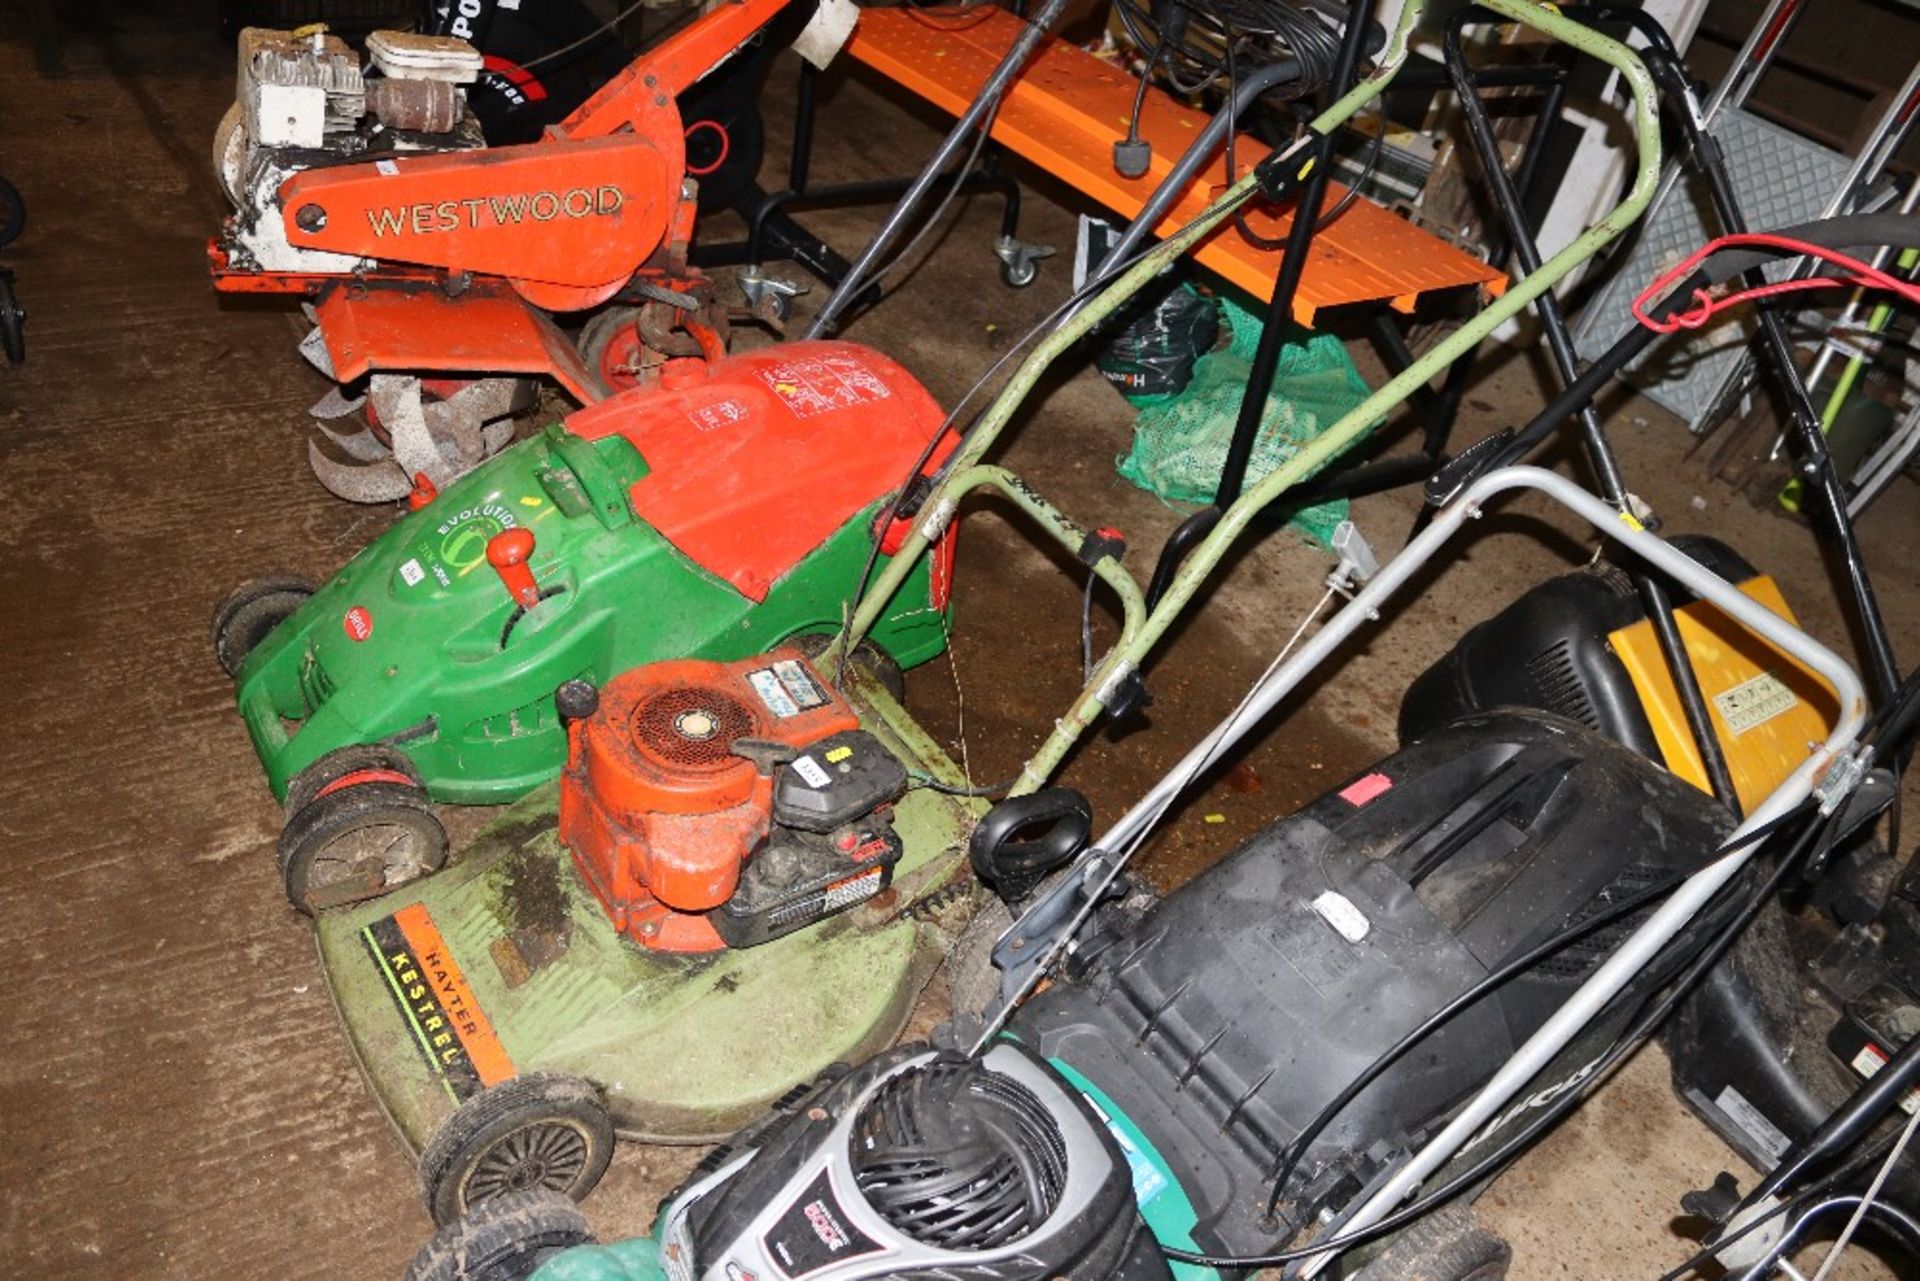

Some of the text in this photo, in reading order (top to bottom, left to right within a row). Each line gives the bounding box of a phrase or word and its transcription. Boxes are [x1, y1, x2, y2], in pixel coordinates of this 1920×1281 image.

[367, 184, 624, 239] WESTWOOD
[391, 951, 459, 1065] KESTREL
[425, 950, 478, 1037] HAYTER
